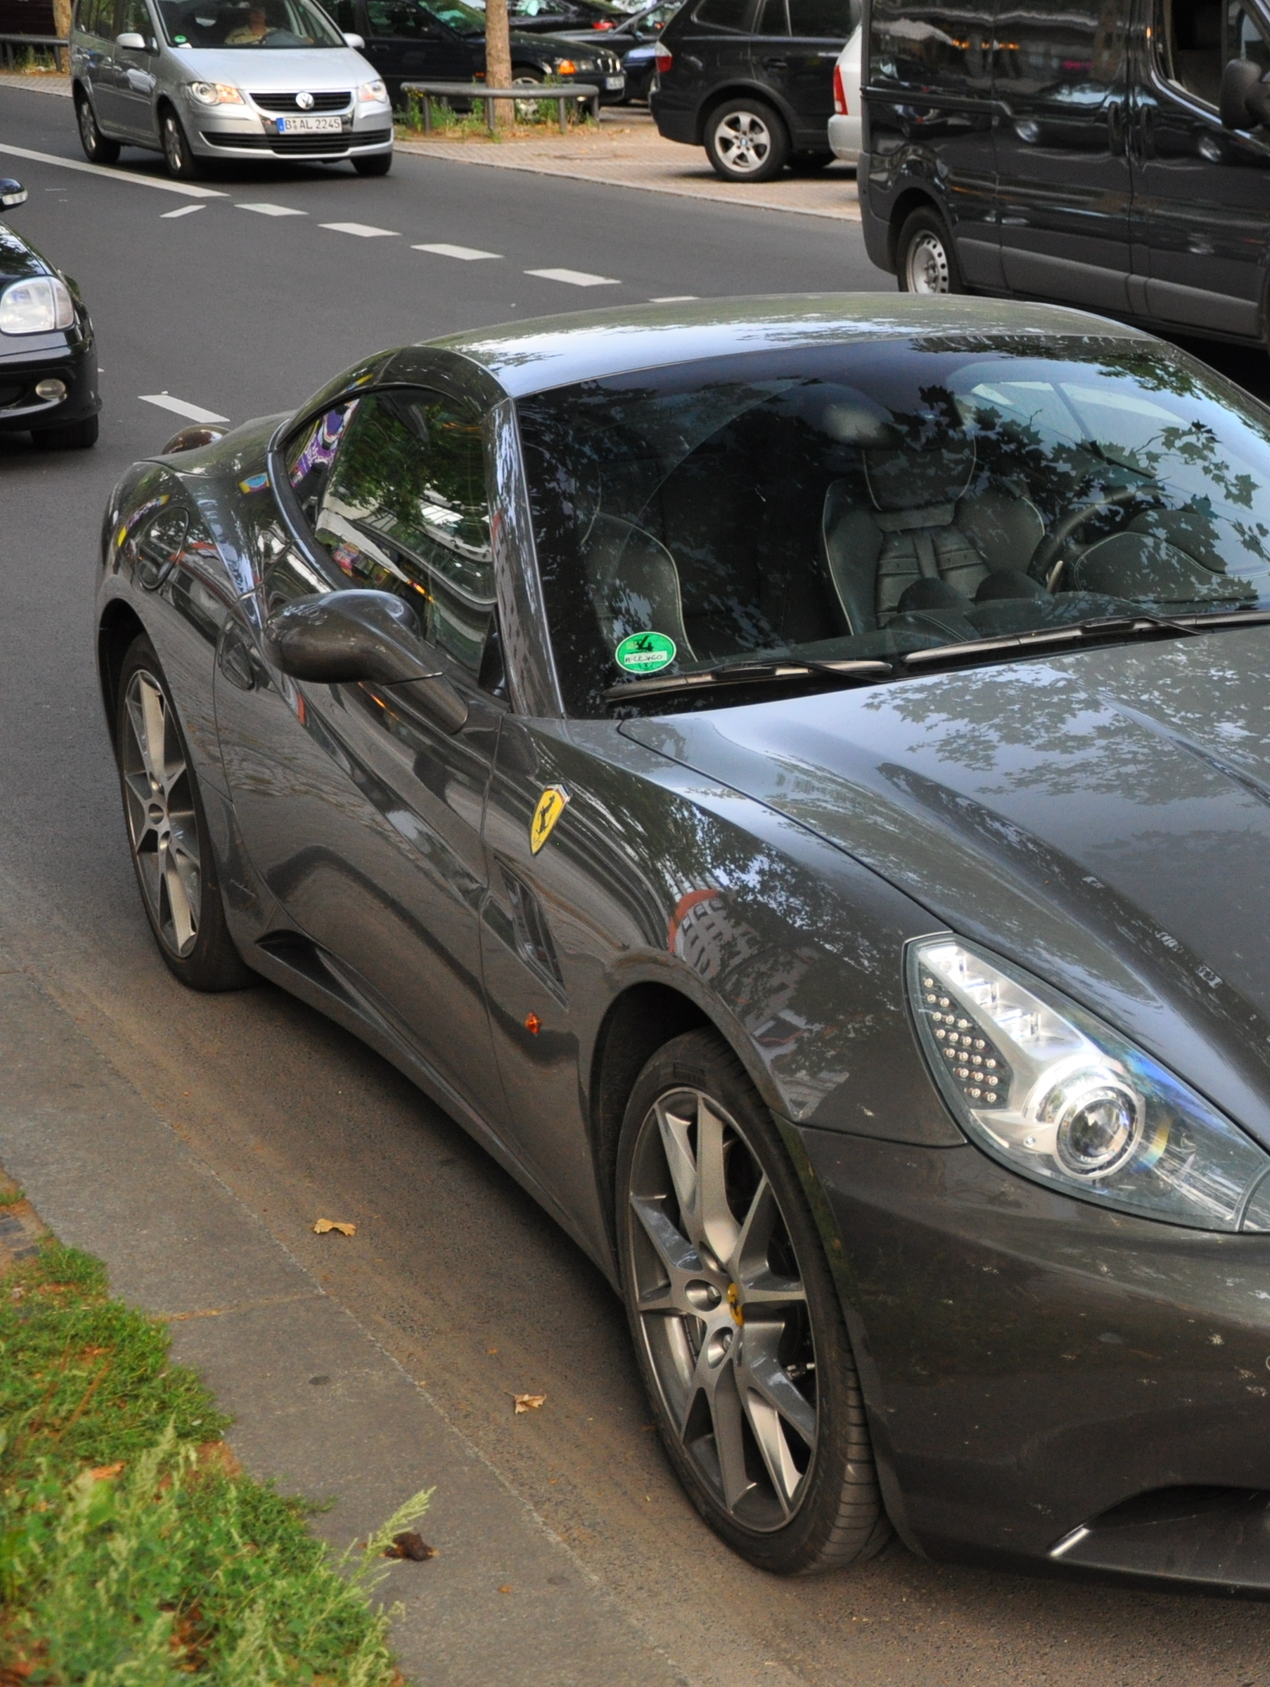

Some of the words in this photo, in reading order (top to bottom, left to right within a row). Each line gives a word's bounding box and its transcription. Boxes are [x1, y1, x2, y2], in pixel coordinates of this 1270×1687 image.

[285, 120, 292, 130] B
[299, 119, 313, 129] AL
[315, 118, 341, 129] 2245
[637, 635, 653, 651] 4
